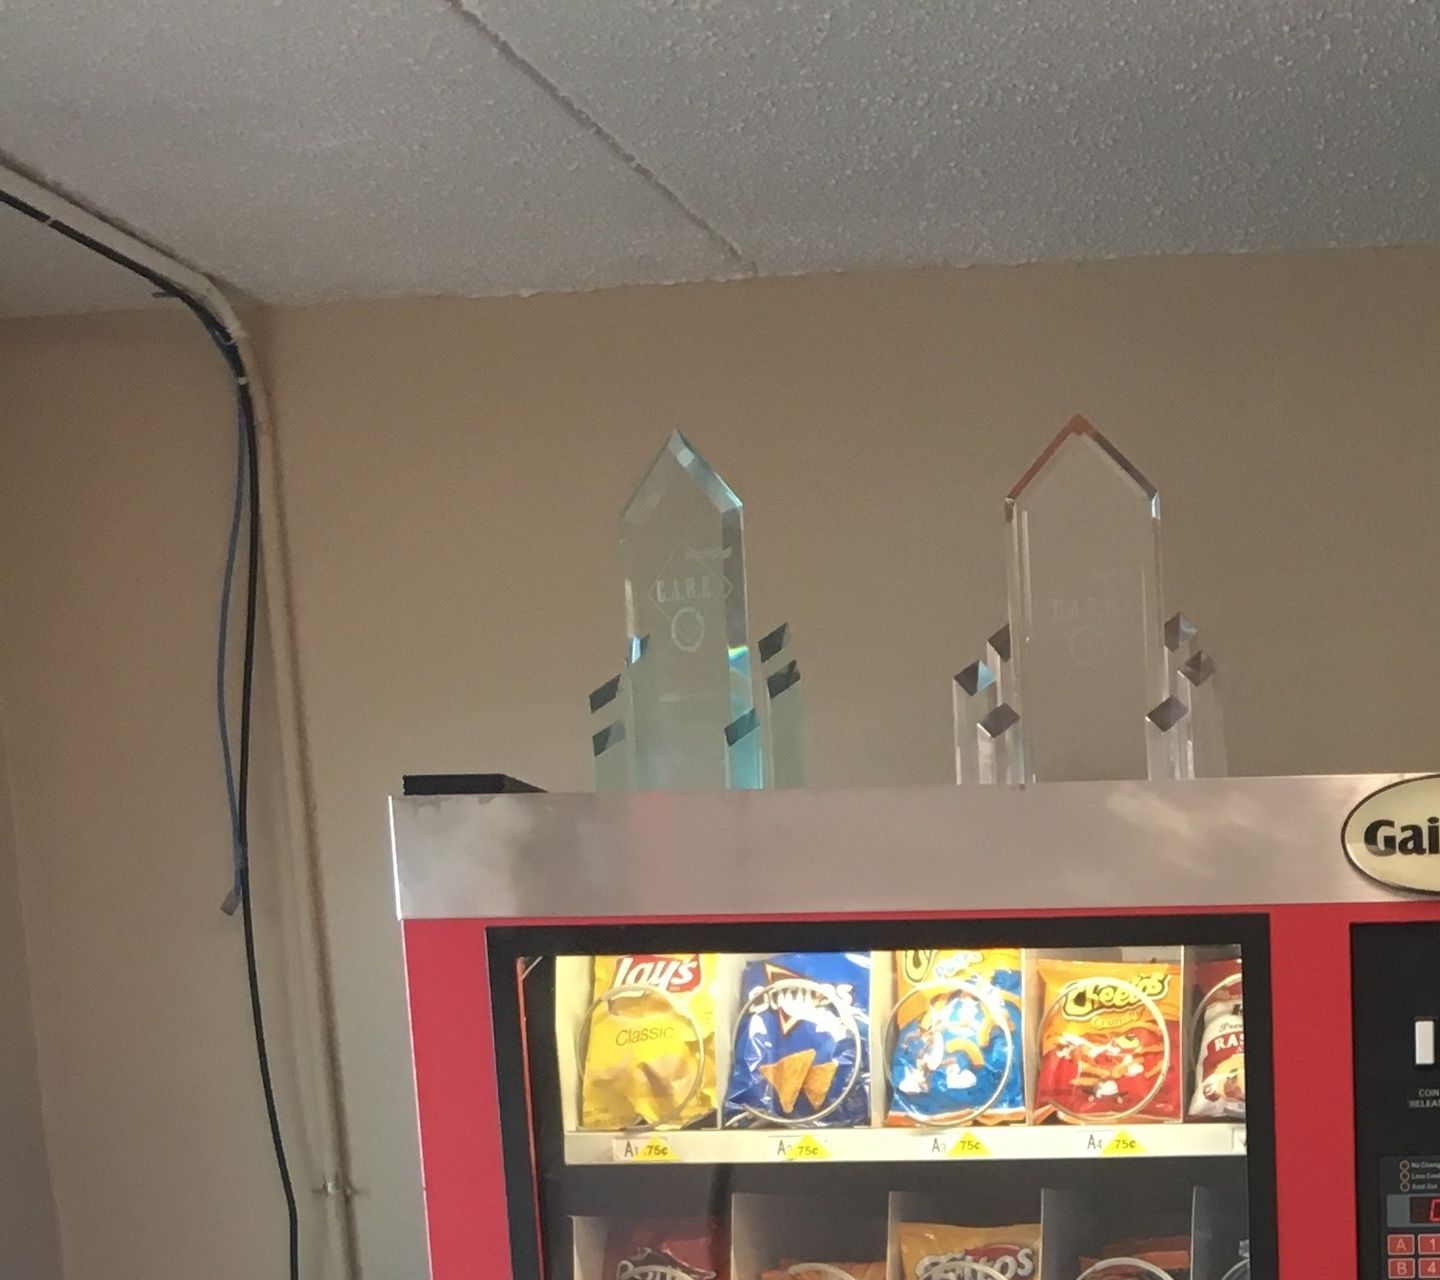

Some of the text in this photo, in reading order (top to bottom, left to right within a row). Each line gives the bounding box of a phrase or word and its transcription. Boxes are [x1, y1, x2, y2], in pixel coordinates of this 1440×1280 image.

[615, 1026, 675, 1047] Classic
[1419, 1089, 1440, 1097] COIN
[1396, 1239, 1407, 1251] A
[1429, 1239, 1436, 1251] 1
[1397, 1262, 1408, 1275] B
[1427, 1262, 1437, 1274] 4
